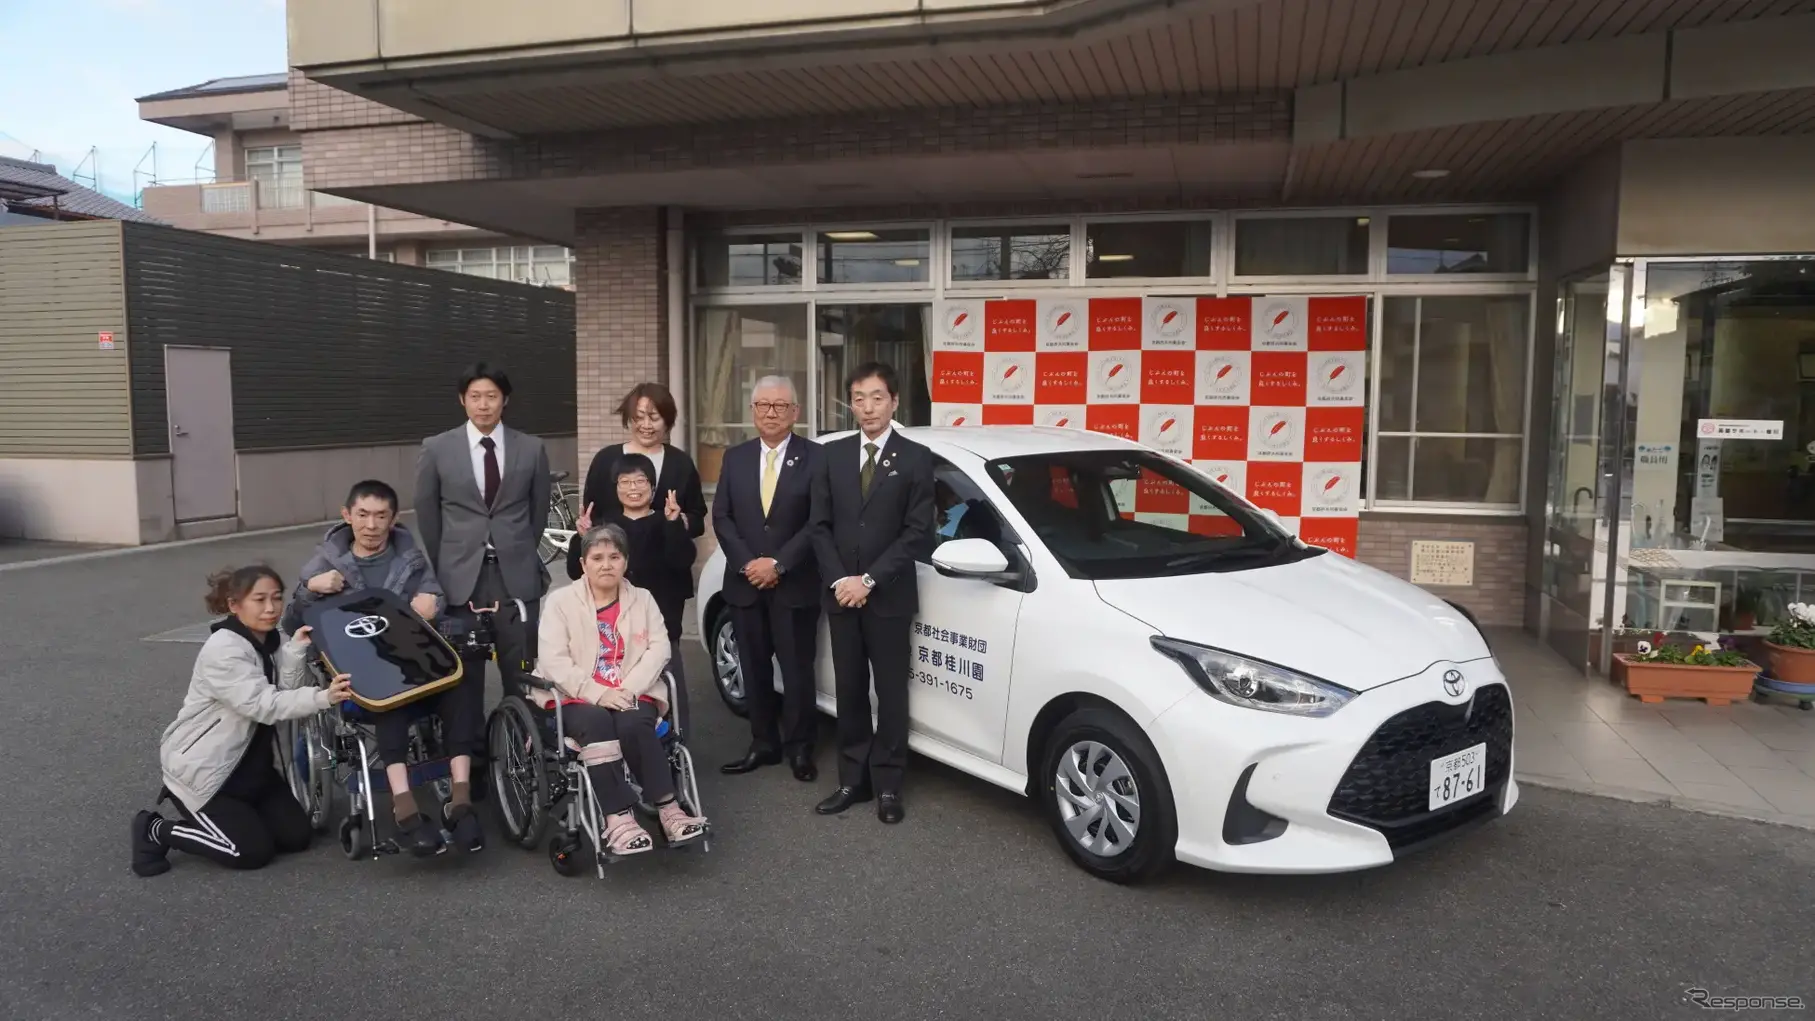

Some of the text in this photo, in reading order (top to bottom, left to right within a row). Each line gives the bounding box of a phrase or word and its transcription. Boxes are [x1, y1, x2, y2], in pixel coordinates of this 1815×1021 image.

[914, 621, 987, 654] 京都社会事業財団
[918, 645, 984, 681] 京都桂川園
